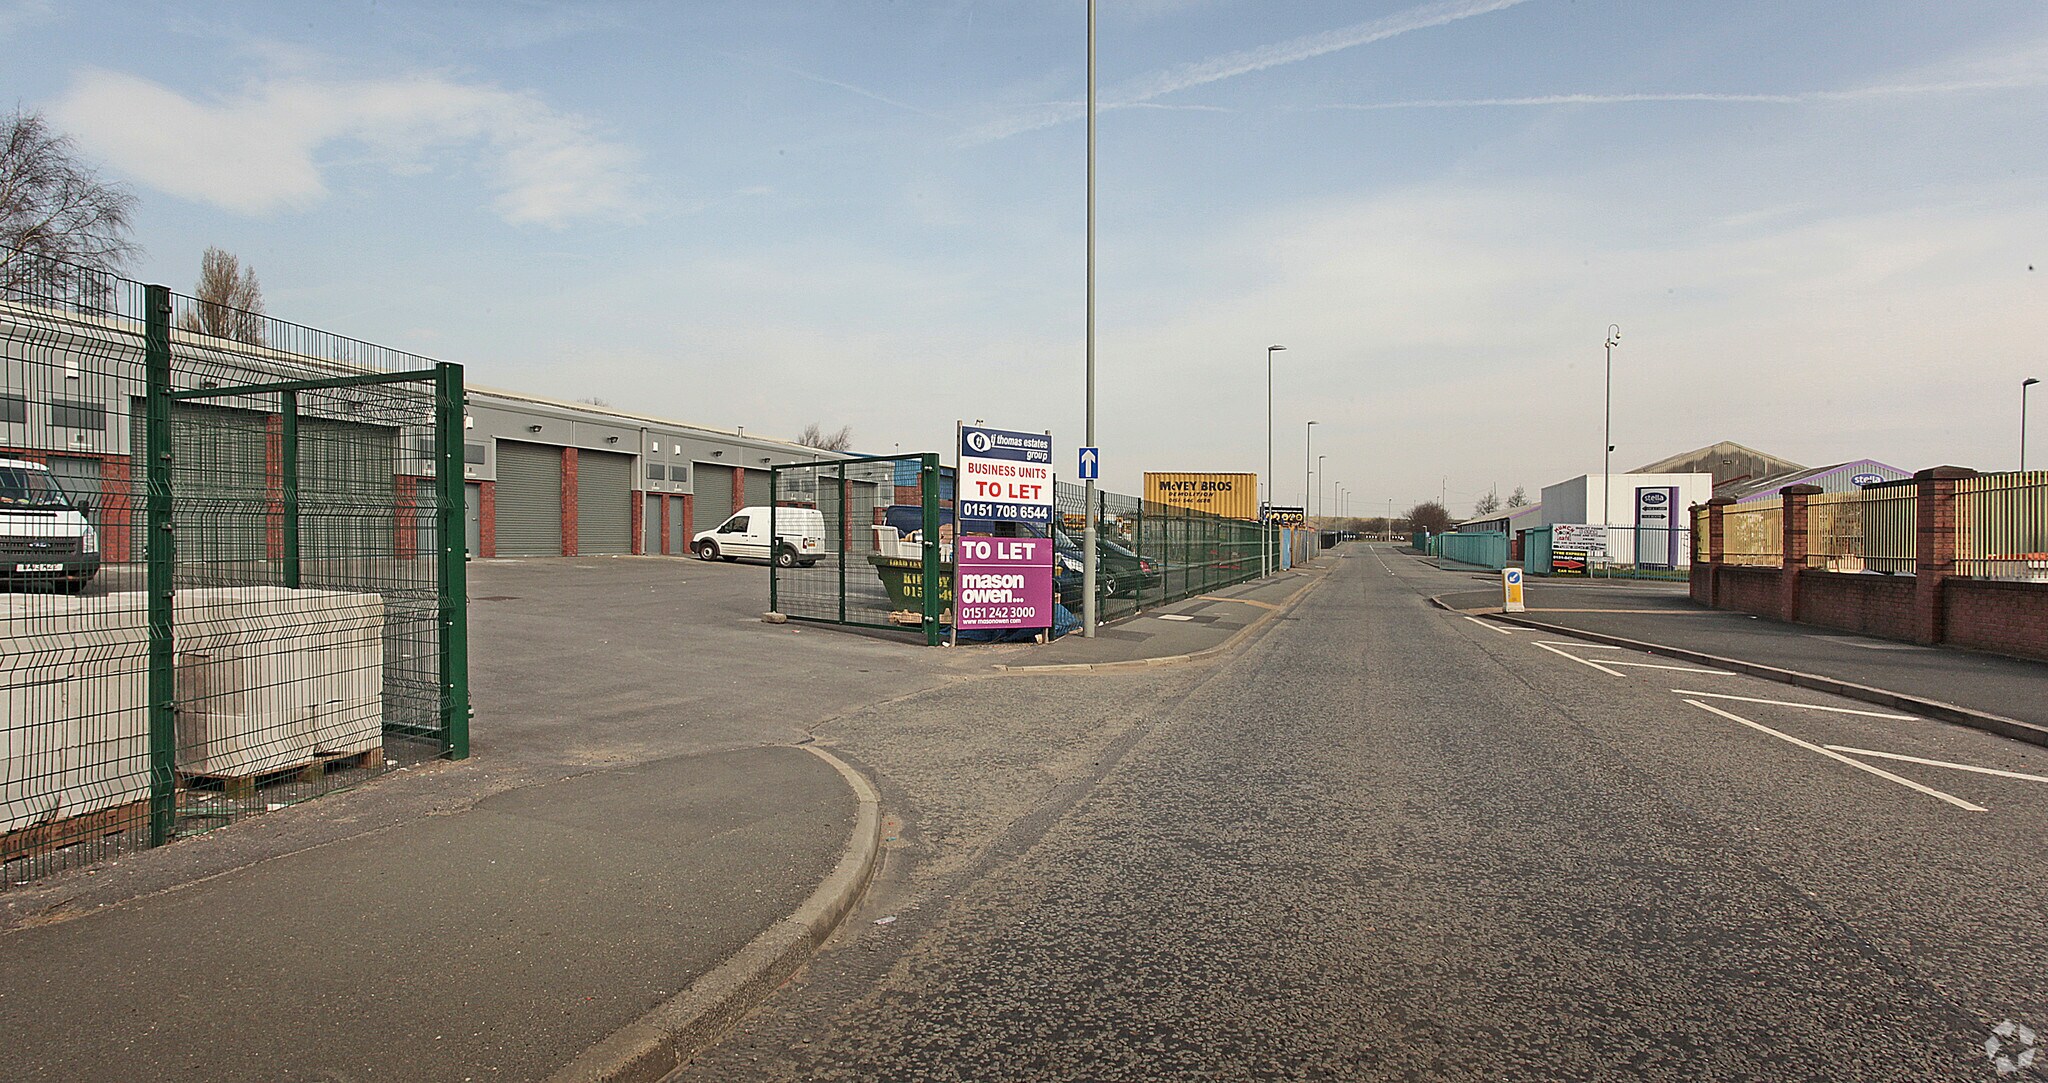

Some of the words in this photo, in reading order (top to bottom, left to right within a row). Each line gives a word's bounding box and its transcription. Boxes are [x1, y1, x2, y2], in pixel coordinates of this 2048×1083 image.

[990, 434, 996, 447] tj
[997, 434, 1023, 447] thomas
[1023, 438, 1048, 449] estates
[1026, 451, 1048, 462] group
[968, 462, 1016, 477] BUSINESS
[1018, 467, 1047, 480] UNITS
[1160, 481, 1197, 491] McVEY
[1201, 481, 1232, 491] BROS
[1854, 475, 1881, 484] stella
[975, 481, 1002, 498] TO
[1008, 483, 1042, 500] LET
[1644, 493, 1664, 502] stella
[963, 503, 993, 518] 0151
[996, 504, 1017, 519] 708
[1019, 506, 1049, 520] 6544
[962, 541, 991, 560] TO
[997, 542, 1036, 560] LET
[962, 574, 1024, 589] mason
[962, 606, 987, 619] 0151
[989, 607, 1008, 619] 242
[1010, 606, 1035, 618] 3000
